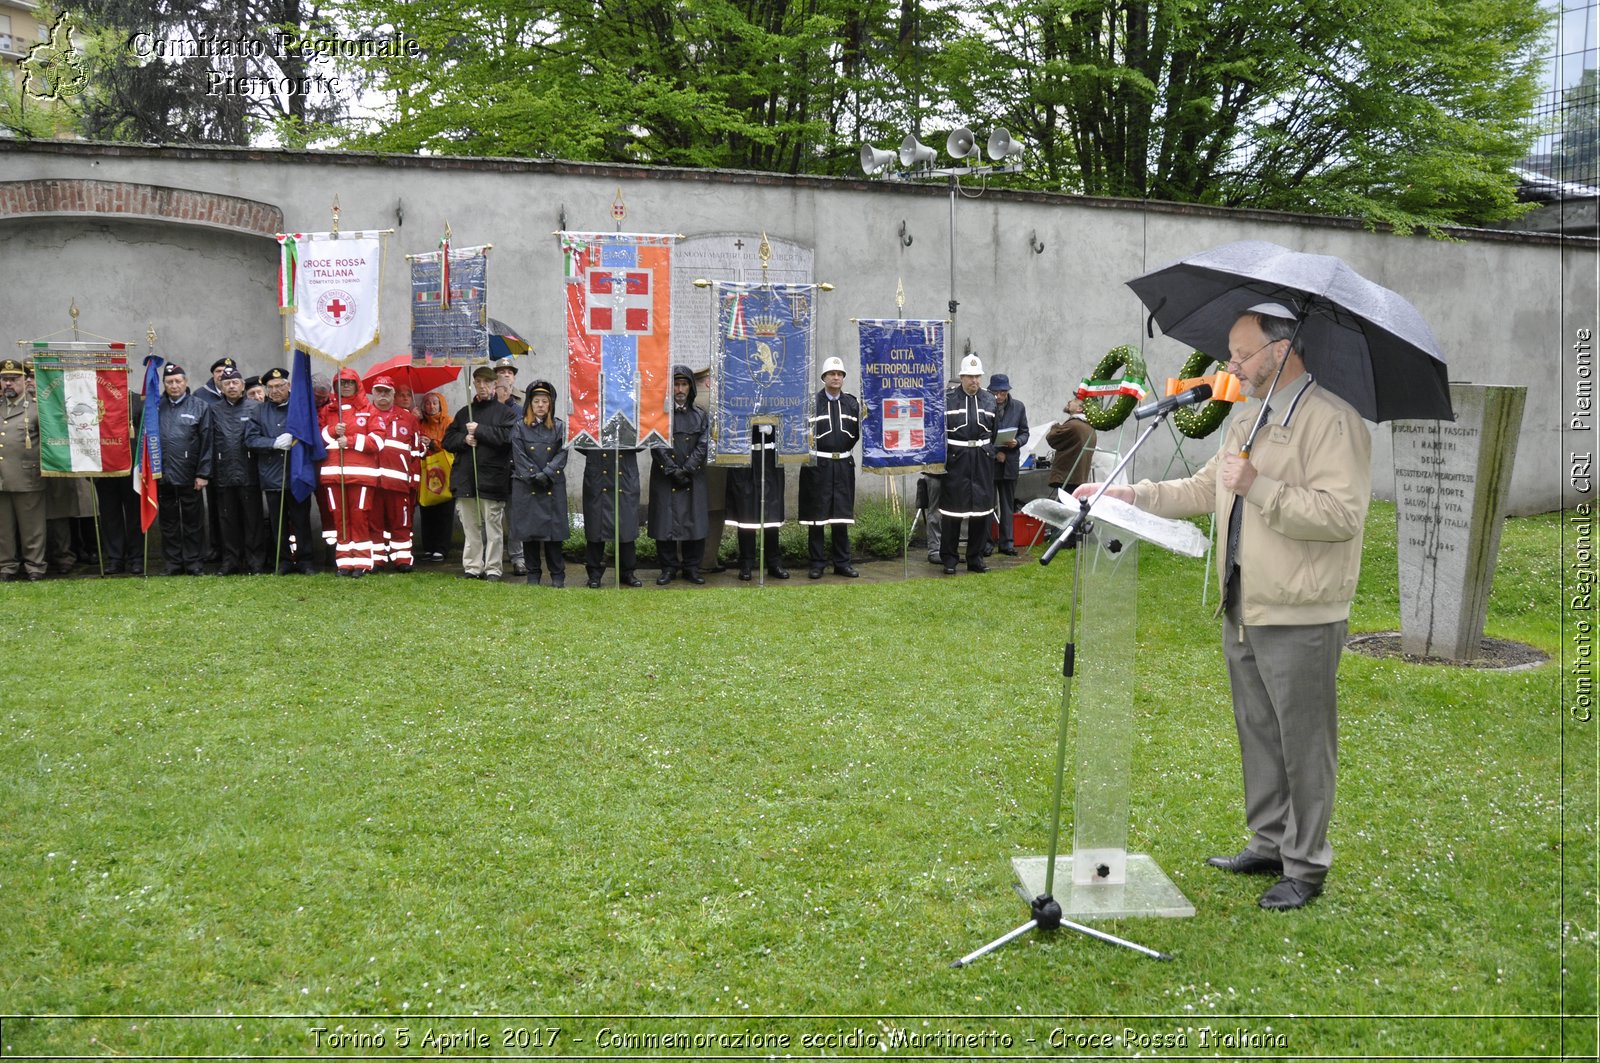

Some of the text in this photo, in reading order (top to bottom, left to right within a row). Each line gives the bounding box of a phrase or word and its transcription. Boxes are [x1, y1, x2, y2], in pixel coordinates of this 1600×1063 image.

[303, 258, 366, 268] CROCE ROSSA
[313, 269, 354, 277] ITALIANA
[890, 347, 915, 360] CITTÀ
[866, 363, 937, 374] METROPOLITANA
[882, 377, 924, 389] DI TORINO
[768, 396, 801, 407] TORINO
[1421, 440, 1456, 451] MARTIRI
[150, 435, 161, 472] TORINO
[1444, 502, 1462, 512] VITA
